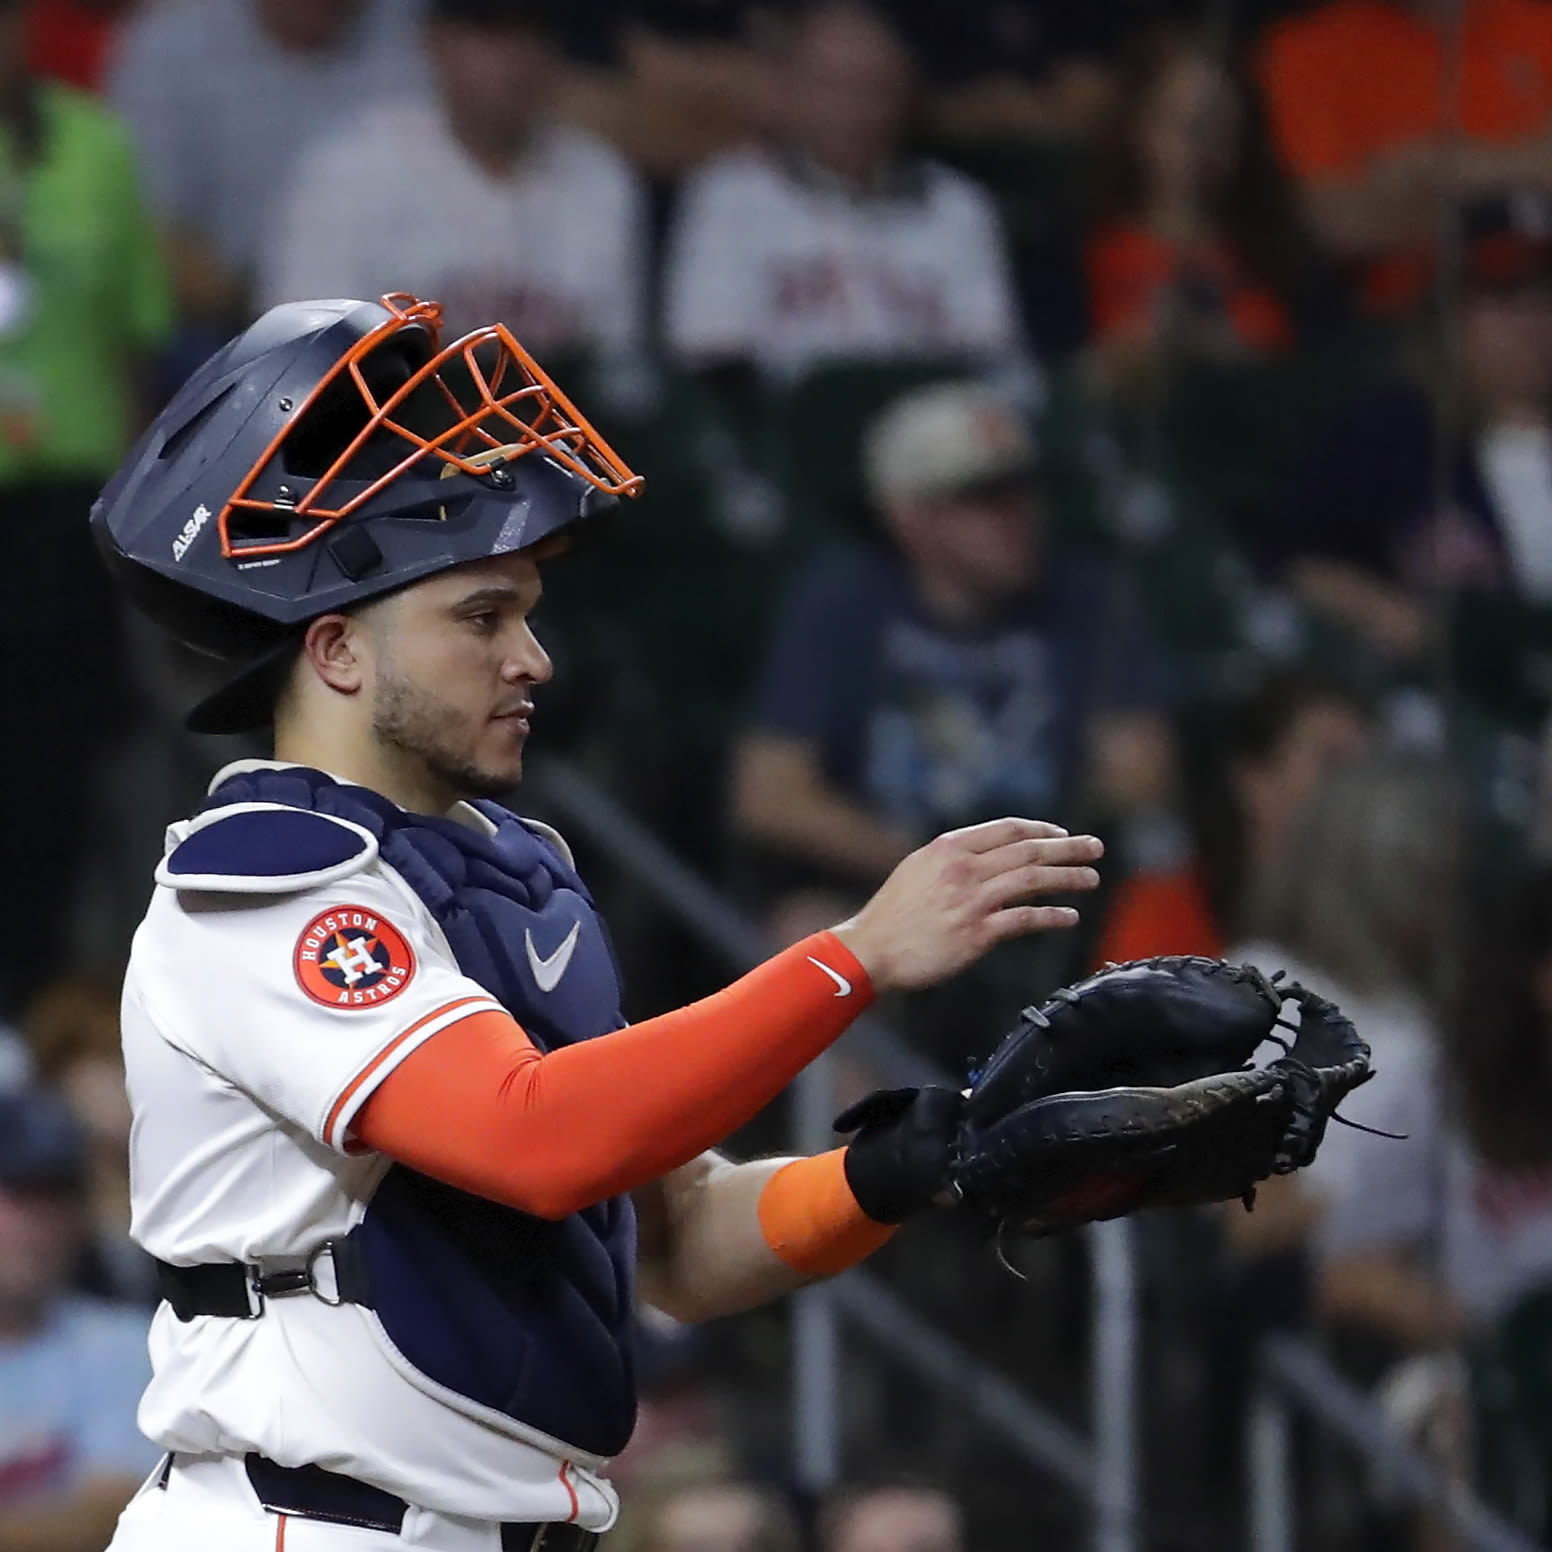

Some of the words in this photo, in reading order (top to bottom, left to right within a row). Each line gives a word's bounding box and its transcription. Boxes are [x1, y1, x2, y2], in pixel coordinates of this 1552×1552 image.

[302, 913, 378, 961] HOUSTON
[326, 936, 383, 985] H
[337, 966, 407, 1003] ASTROS
